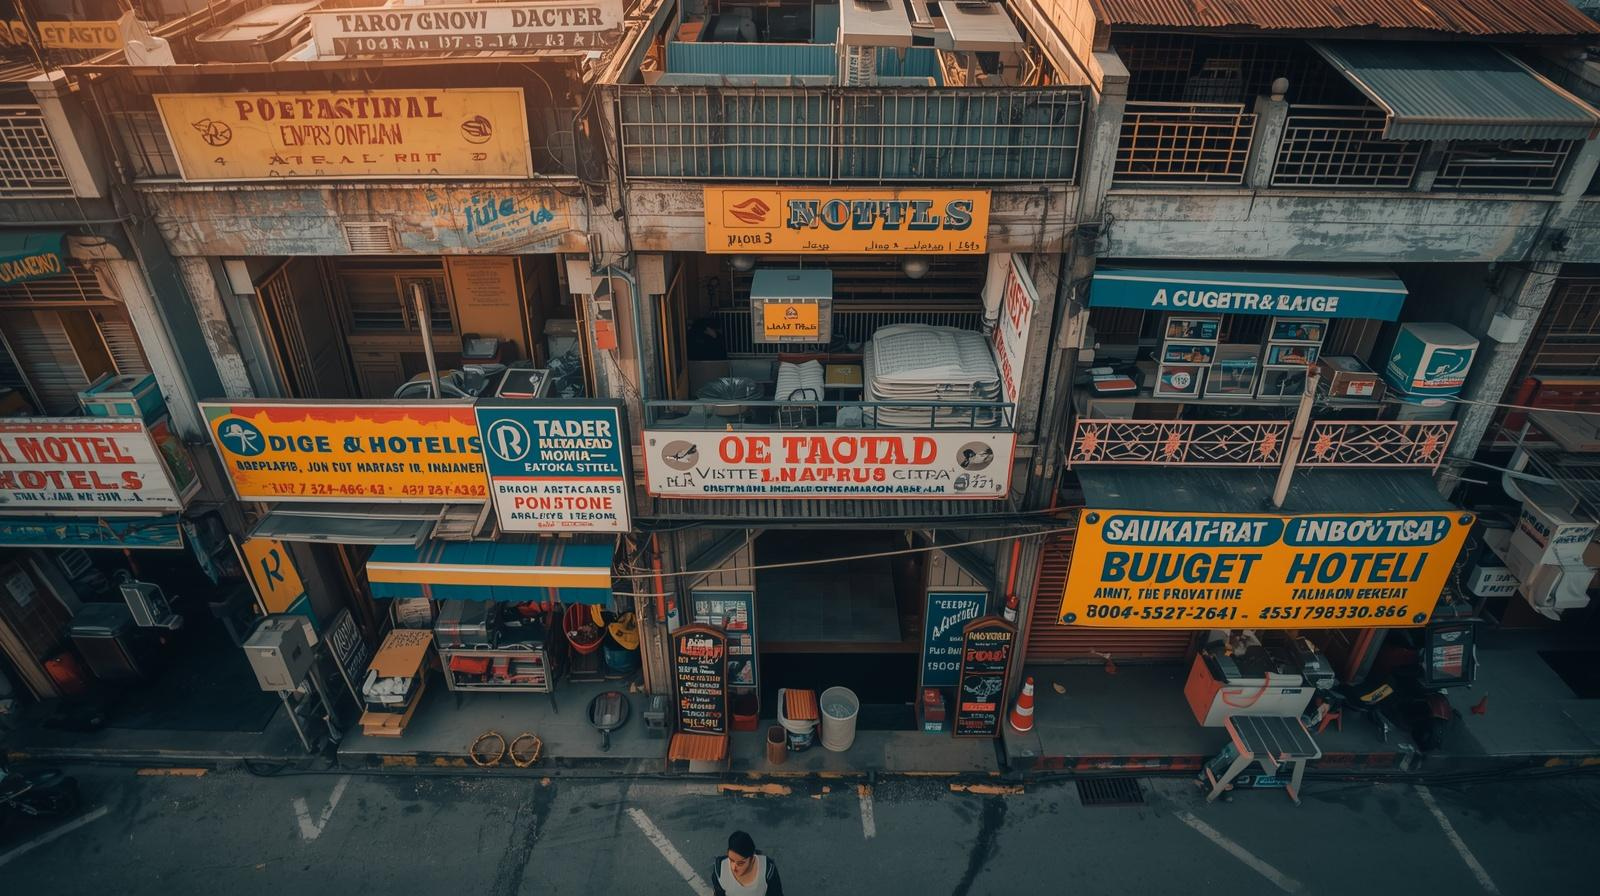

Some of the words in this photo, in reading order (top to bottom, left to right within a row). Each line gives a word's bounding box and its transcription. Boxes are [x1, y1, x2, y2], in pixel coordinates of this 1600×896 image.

[511, 7, 603, 27] DACTER
[1152, 289, 1168, 306] A
[534, 420, 612, 438] TADER
[268, 435, 332, 453] DIGE
[719, 436, 772, 464] OE
[261, 549, 284, 592] R
[1285, 552, 1429, 584] HOTELI
